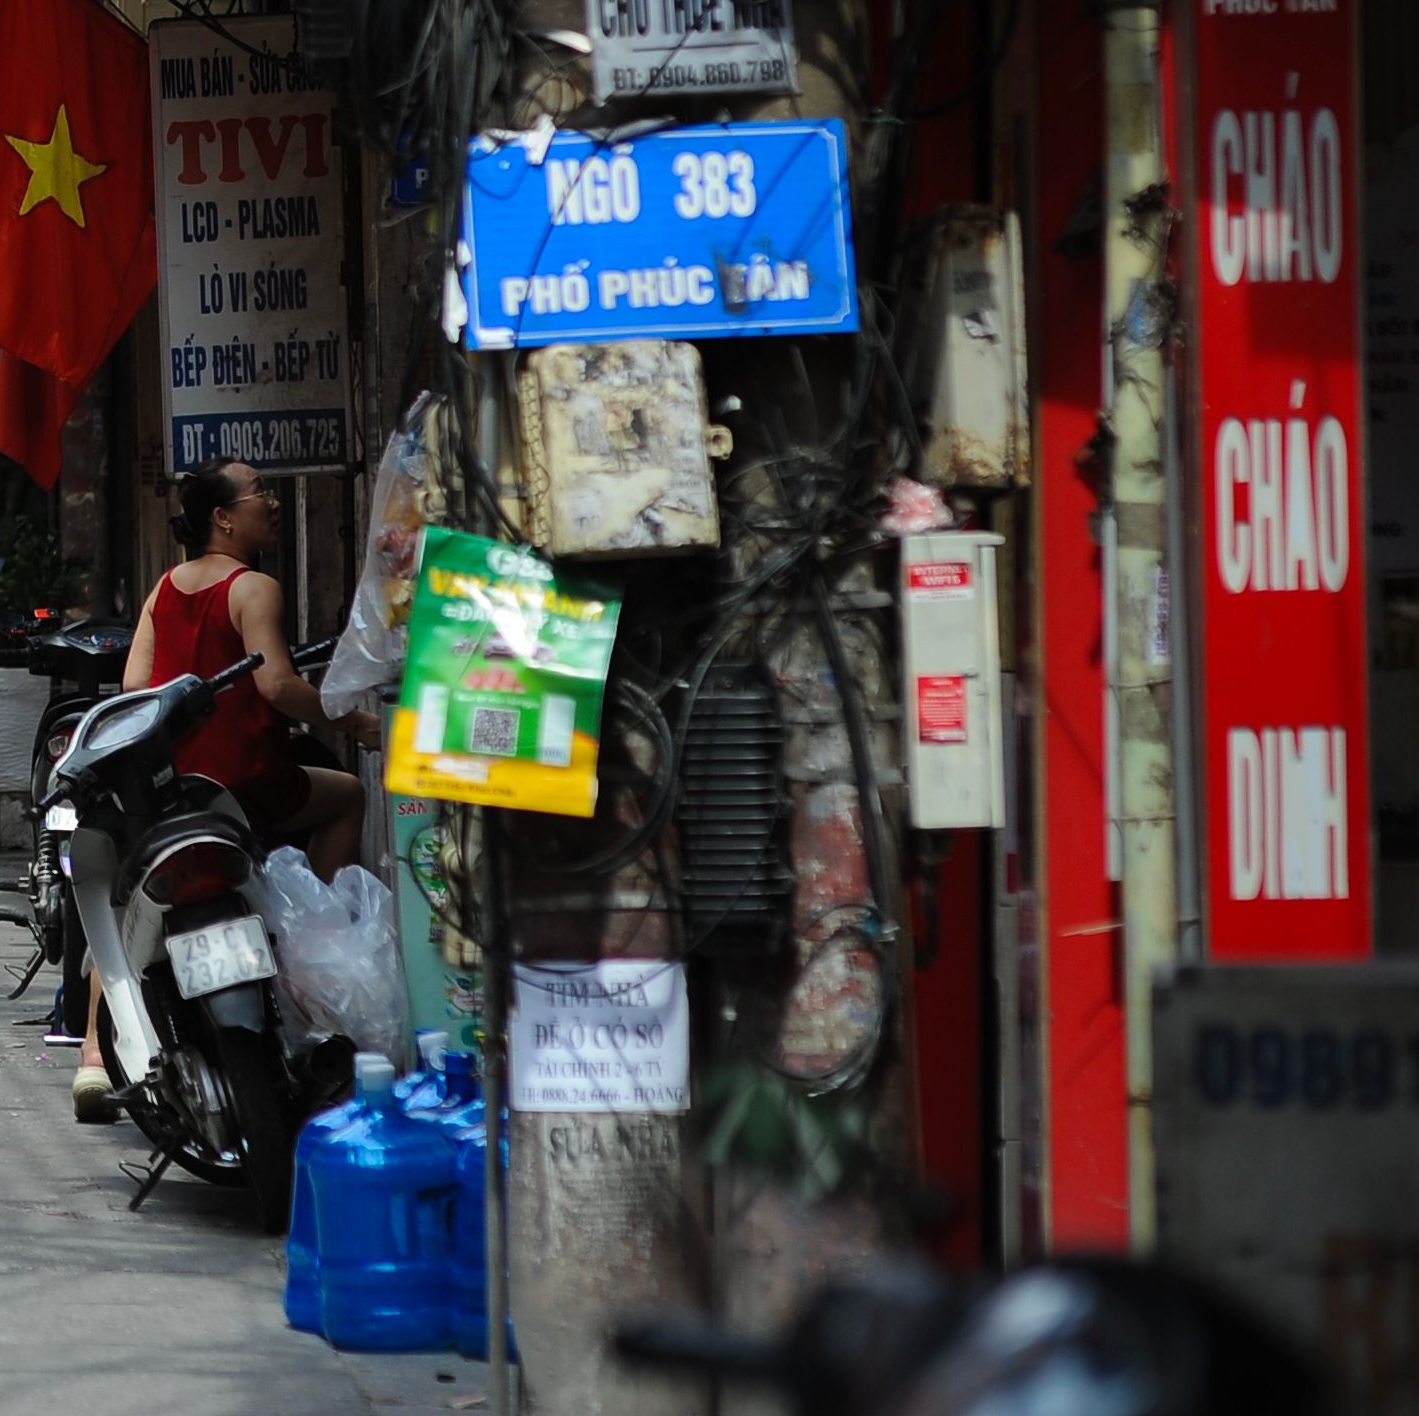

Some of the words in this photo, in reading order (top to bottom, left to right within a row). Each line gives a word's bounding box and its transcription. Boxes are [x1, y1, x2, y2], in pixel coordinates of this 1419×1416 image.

[161, 57, 197, 99] MUA
[201, 47, 234, 98] BÁN
[167, 113, 330, 185] TIVI
[1210, 71, 1342, 287] CHÁO
[546, 143, 641, 226] NGÕ
[673, 149, 758, 220] 383
[181, 200, 219, 244] LCD
[238, 195, 320, 242] PLASMA
[200, 262, 224, 315] LÒ
[229, 271, 248, 313] VI
[254, 260, 308, 312] SÓNG
[501, 258, 591, 317] PHỐ
[600, 256, 715, 311] PHÚC
[171, 333, 207, 388] BẾP
[212, 335, 256, 394] ĐIỆN
[274, 327, 310, 383] BẾP
[182, 423, 205, 466] ĐT
[220, 416, 340, 463] 0903.206.725
[1214, 380, 1349, 595] CHÁO
[1227, 727, 1350, 901] DINH
[593, 1016, 628, 1050] CÓ
[562, 1058, 612, 1079] CHÍNH
